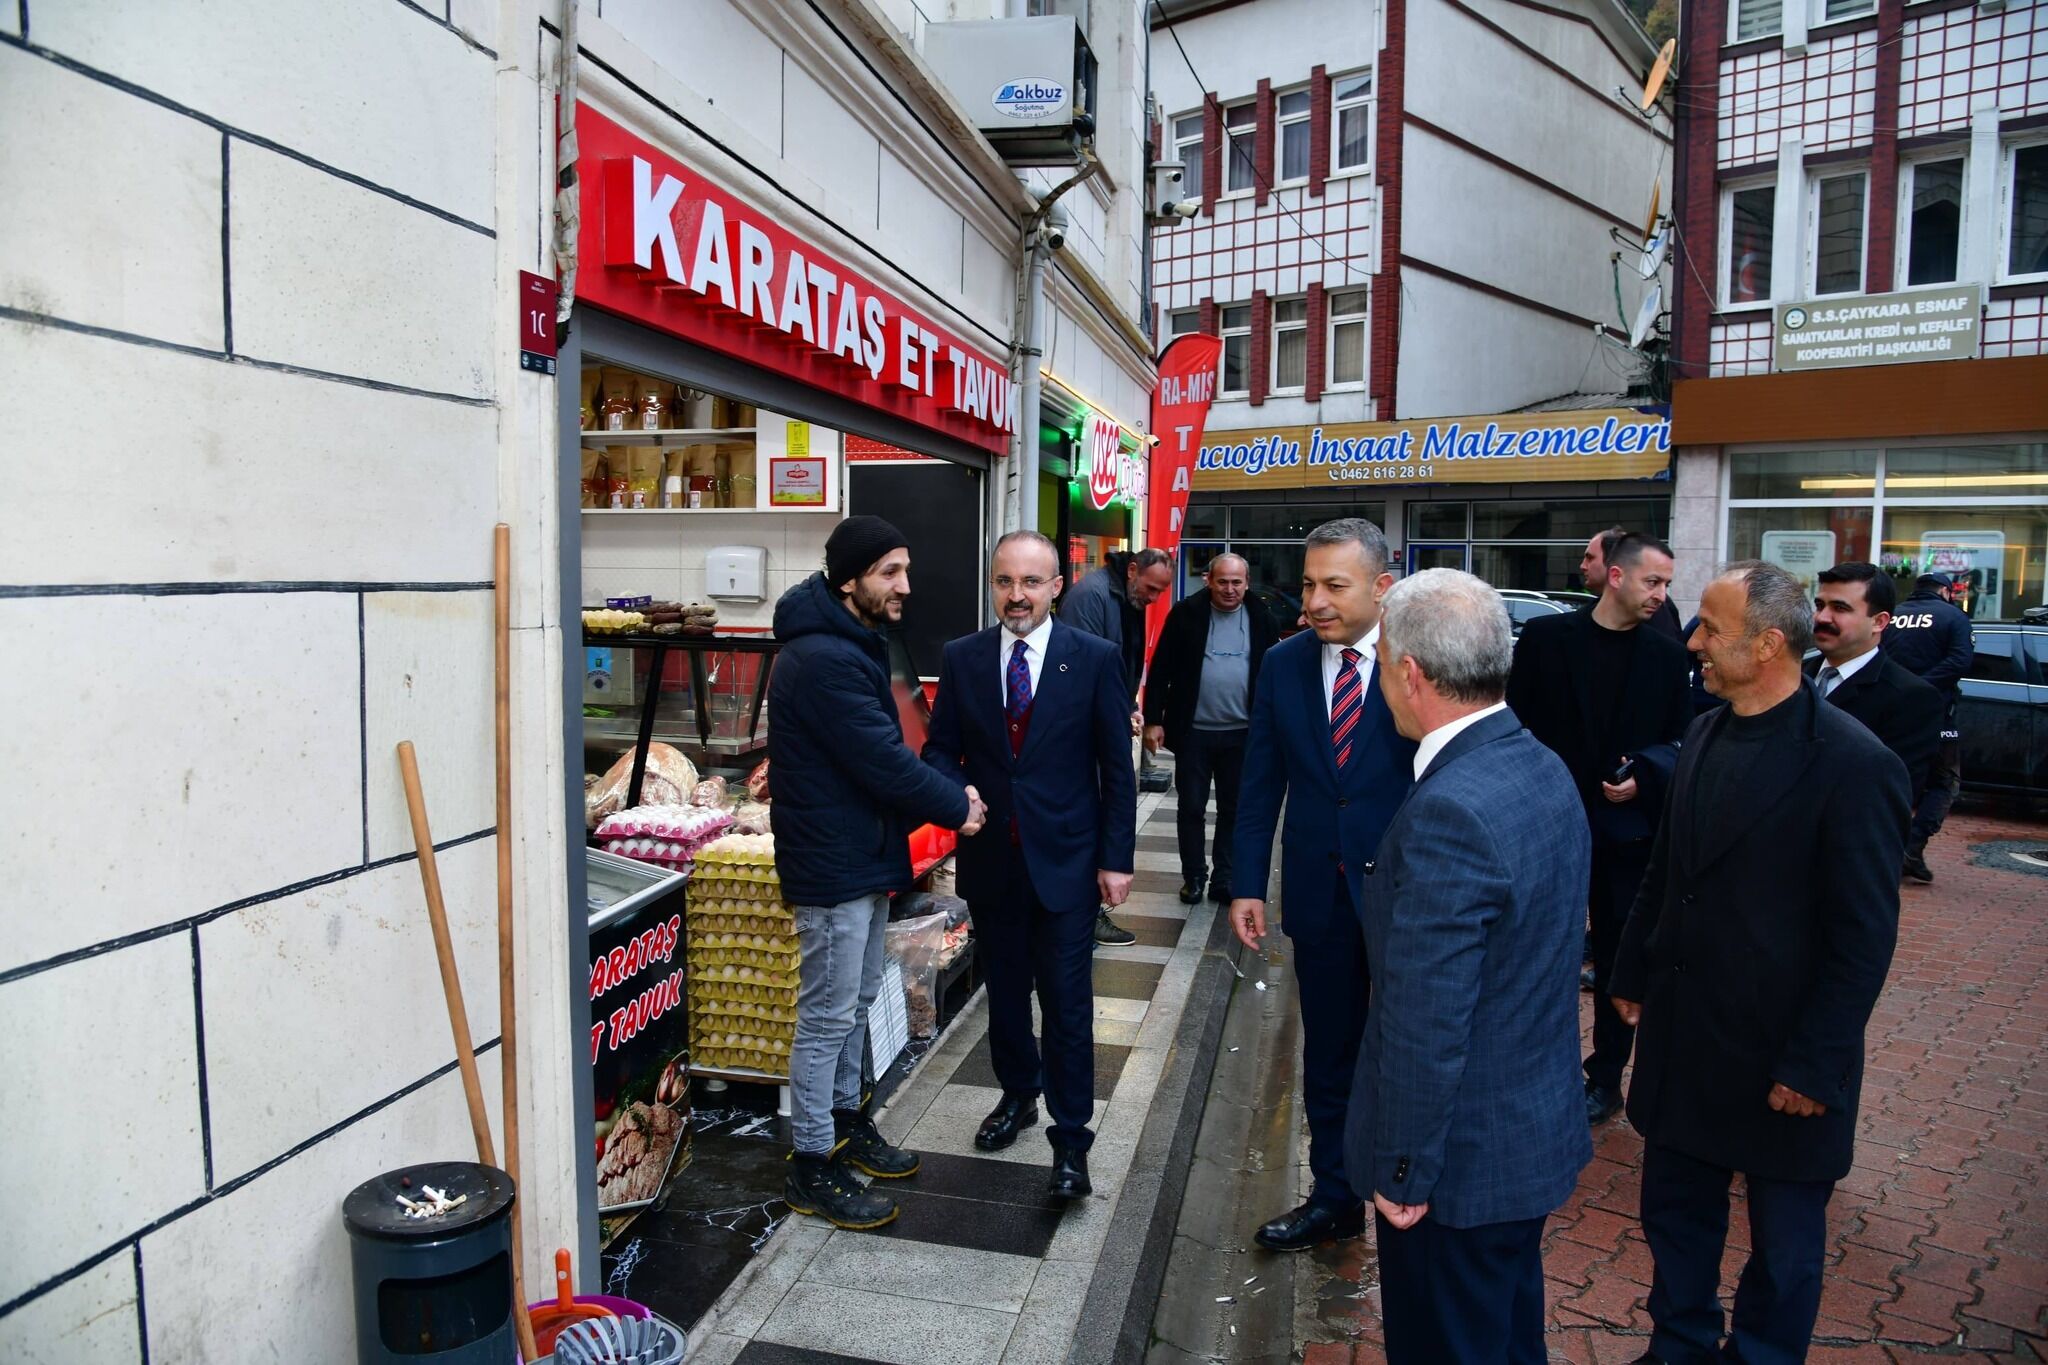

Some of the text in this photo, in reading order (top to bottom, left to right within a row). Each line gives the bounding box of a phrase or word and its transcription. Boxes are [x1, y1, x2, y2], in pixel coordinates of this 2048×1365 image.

[633, 155, 1019, 436] KARATAŞ ET TAVUK
[1915, 298, 1968, 314] ESNAF
[530, 309, 546, 338] 1C
[1782, 318, 1973, 346] SANATKARLAR KREDİ ve KEFALET
[1796, 338, 1952, 362] KOOPERATİFİ BAŞKANLIĞI
[1307, 427, 1416, 468] İnşaat
[1420, 415, 1671, 461] Malzemeleri
[1340, 465, 1434, 480] 0462 616 28 61
[589, 913, 681, 1001] ARATAŞ
[609, 967, 683, 1050] TAVUK
